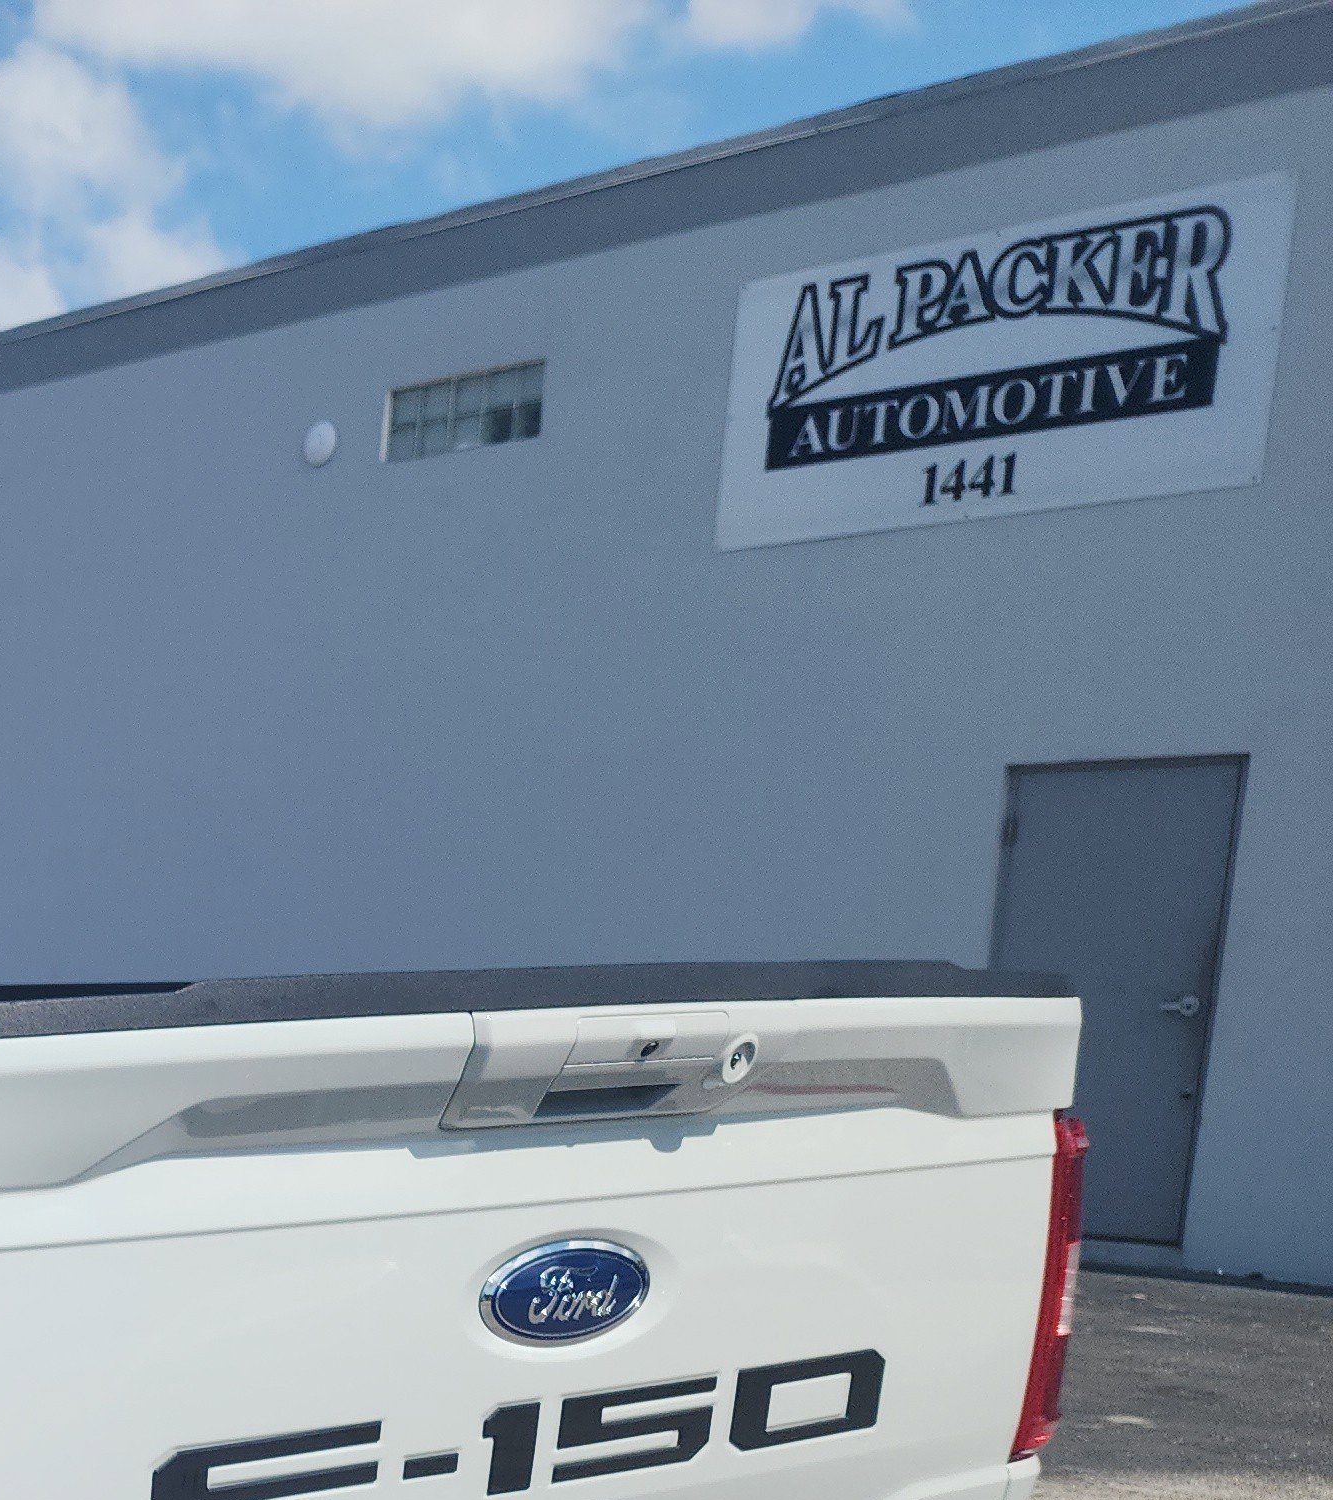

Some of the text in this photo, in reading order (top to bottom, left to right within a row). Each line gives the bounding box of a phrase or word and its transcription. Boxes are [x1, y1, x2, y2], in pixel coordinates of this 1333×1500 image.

[767, 204, 1232, 415] AL PACKER
[789, 353, 1190, 457] AUTOMOTIVE
[920, 452, 1018, 507] 1441
